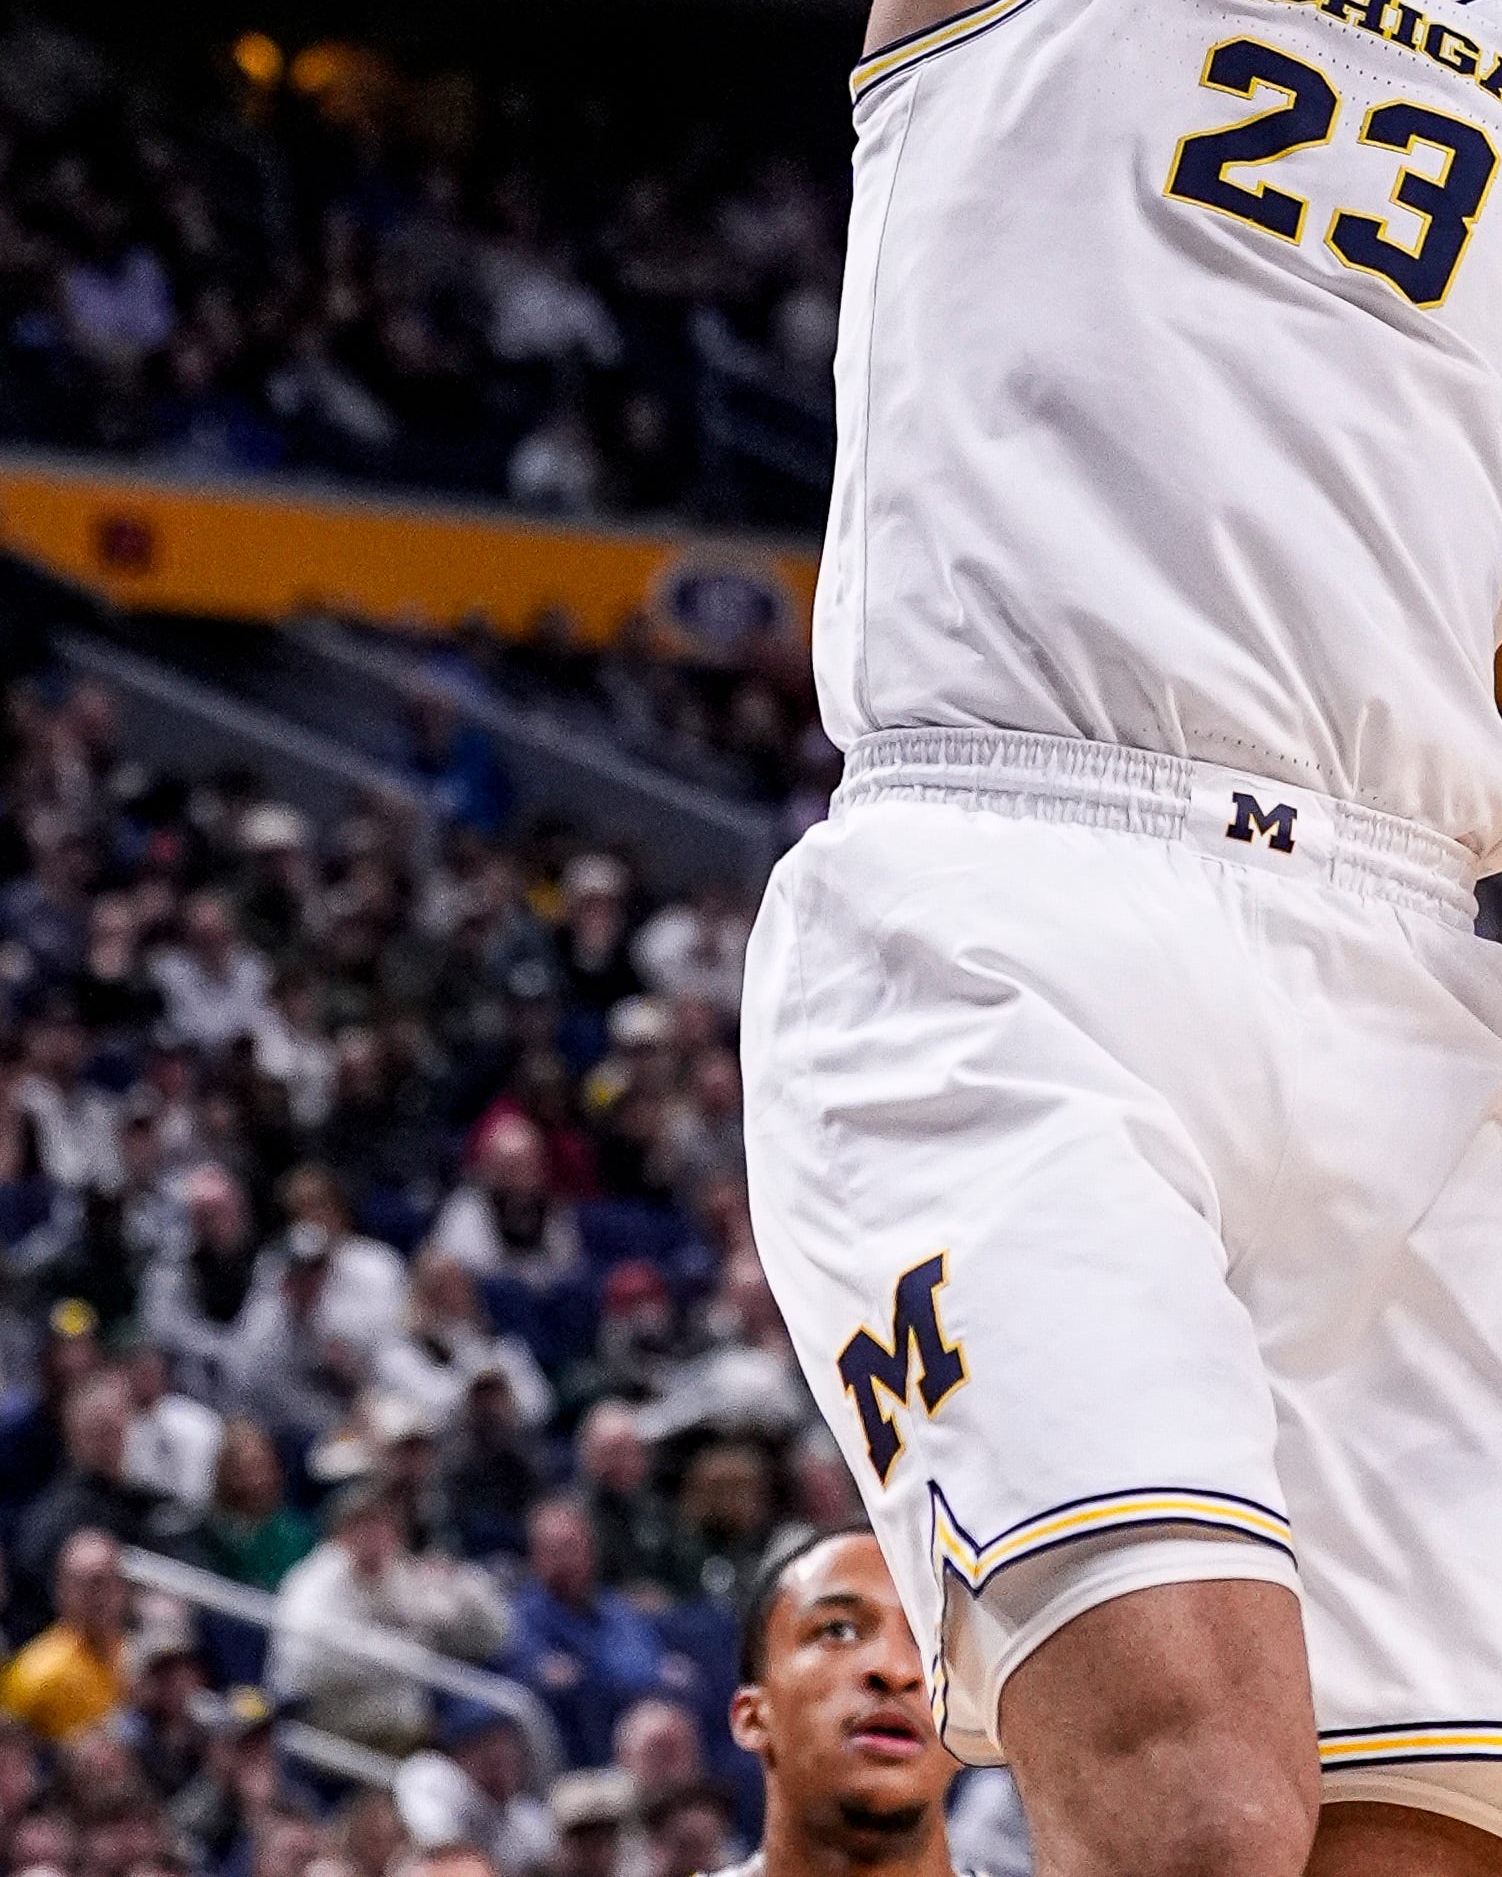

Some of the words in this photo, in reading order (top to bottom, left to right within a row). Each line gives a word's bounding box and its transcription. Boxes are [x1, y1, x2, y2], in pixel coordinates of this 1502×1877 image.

[1163, 35, 1501, 310] 23
[1225, 791, 1298, 854] M
[837, 1248, 970, 1491] M
